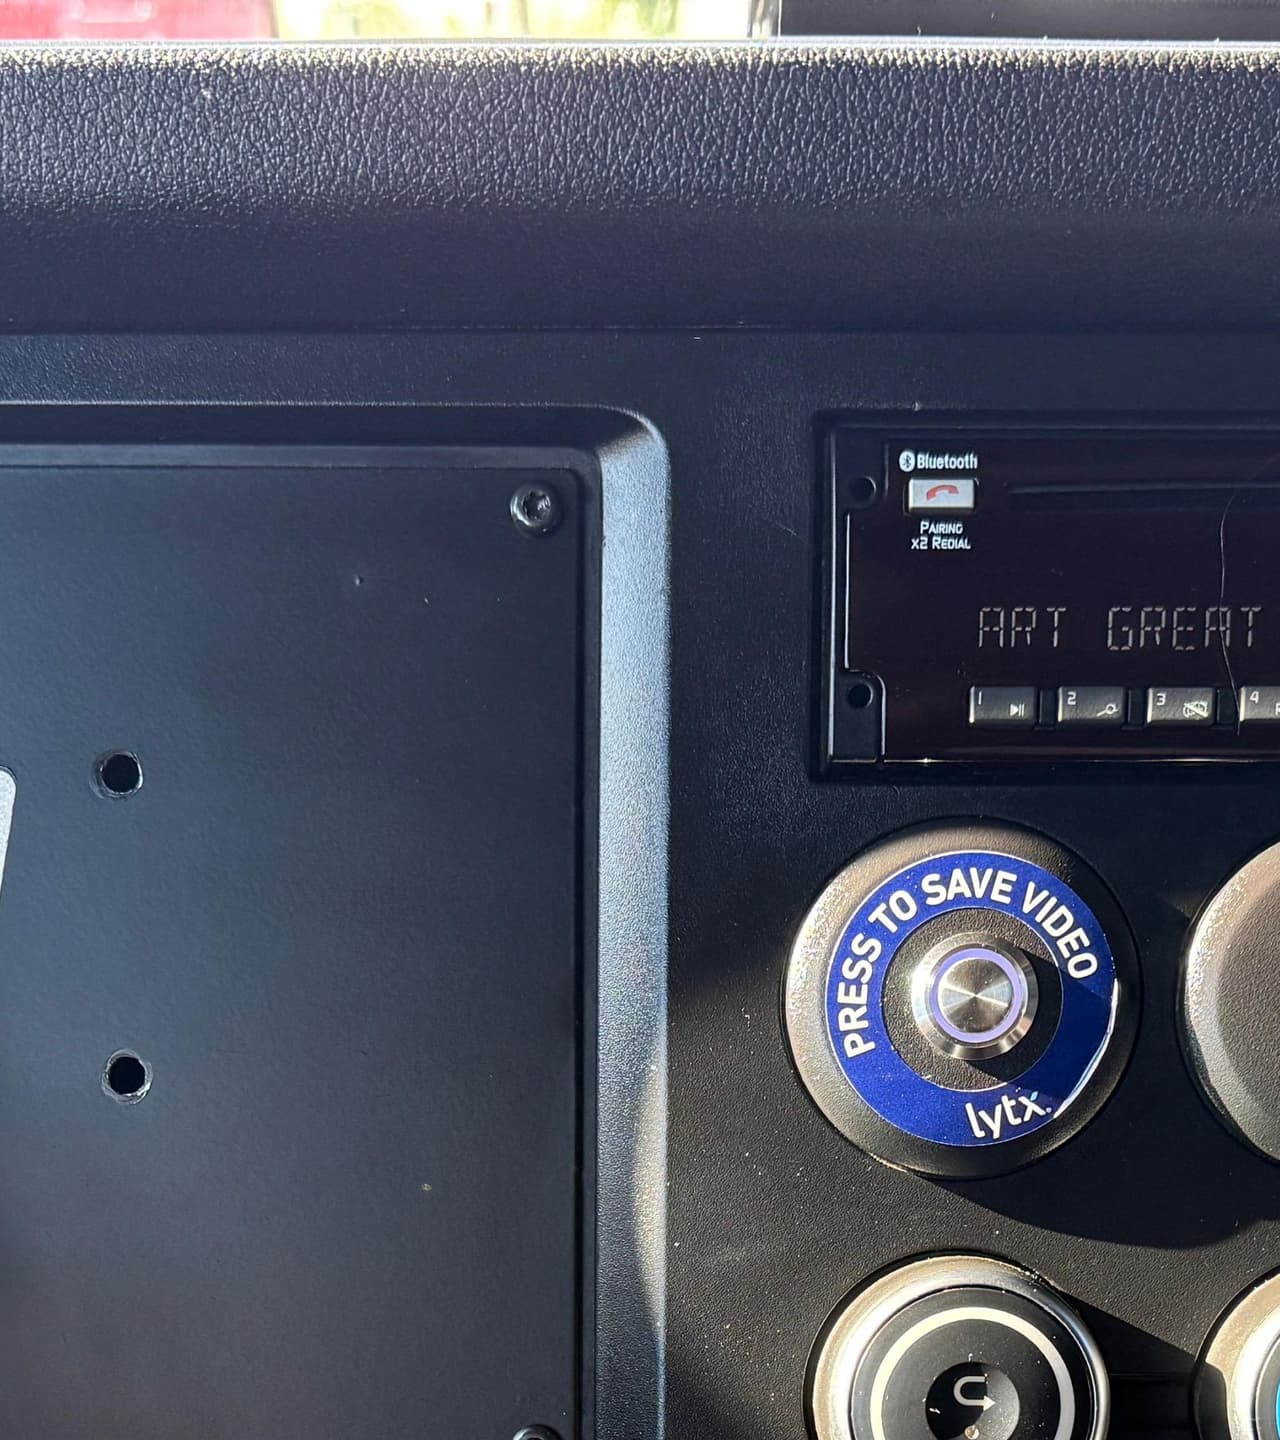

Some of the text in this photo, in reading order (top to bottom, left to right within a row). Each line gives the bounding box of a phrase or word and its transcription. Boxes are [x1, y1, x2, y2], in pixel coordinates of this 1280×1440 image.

[917, 451, 978, 470] Bluetooth
[978, 606, 1067, 650] ART
[1106, 606, 1263, 651] GREAT
[1066, 691, 1077, 706] 2
[1156, 693, 1167, 706] 3
[1249, 690, 1260, 705] 4
[837, 867, 1099, 1058] PRESS TO SAVE VIDEO
[965, 1091, 1047, 1140] lytx
